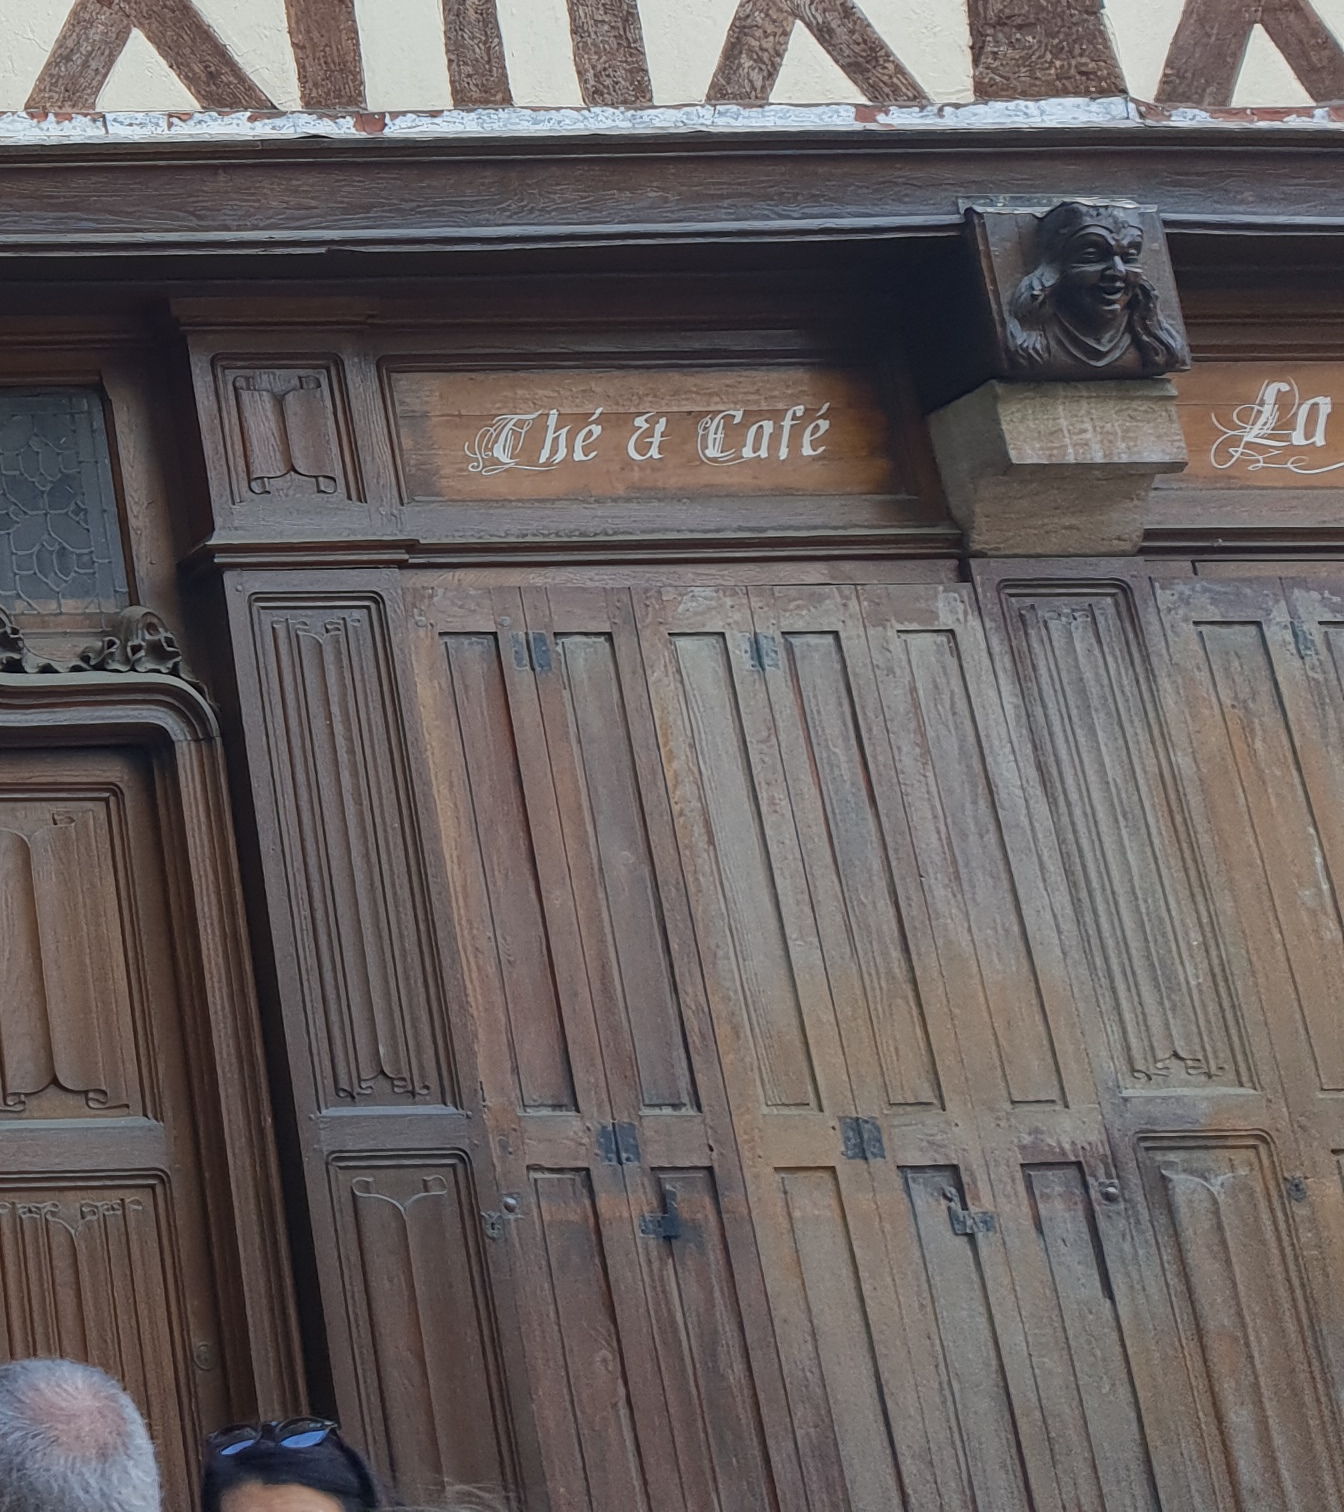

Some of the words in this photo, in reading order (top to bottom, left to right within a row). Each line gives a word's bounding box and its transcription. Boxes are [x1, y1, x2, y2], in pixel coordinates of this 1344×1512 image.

[465, 407, 604, 475] Thé
[626, 411, 672, 461] &
[697, 402, 831, 466] Café
